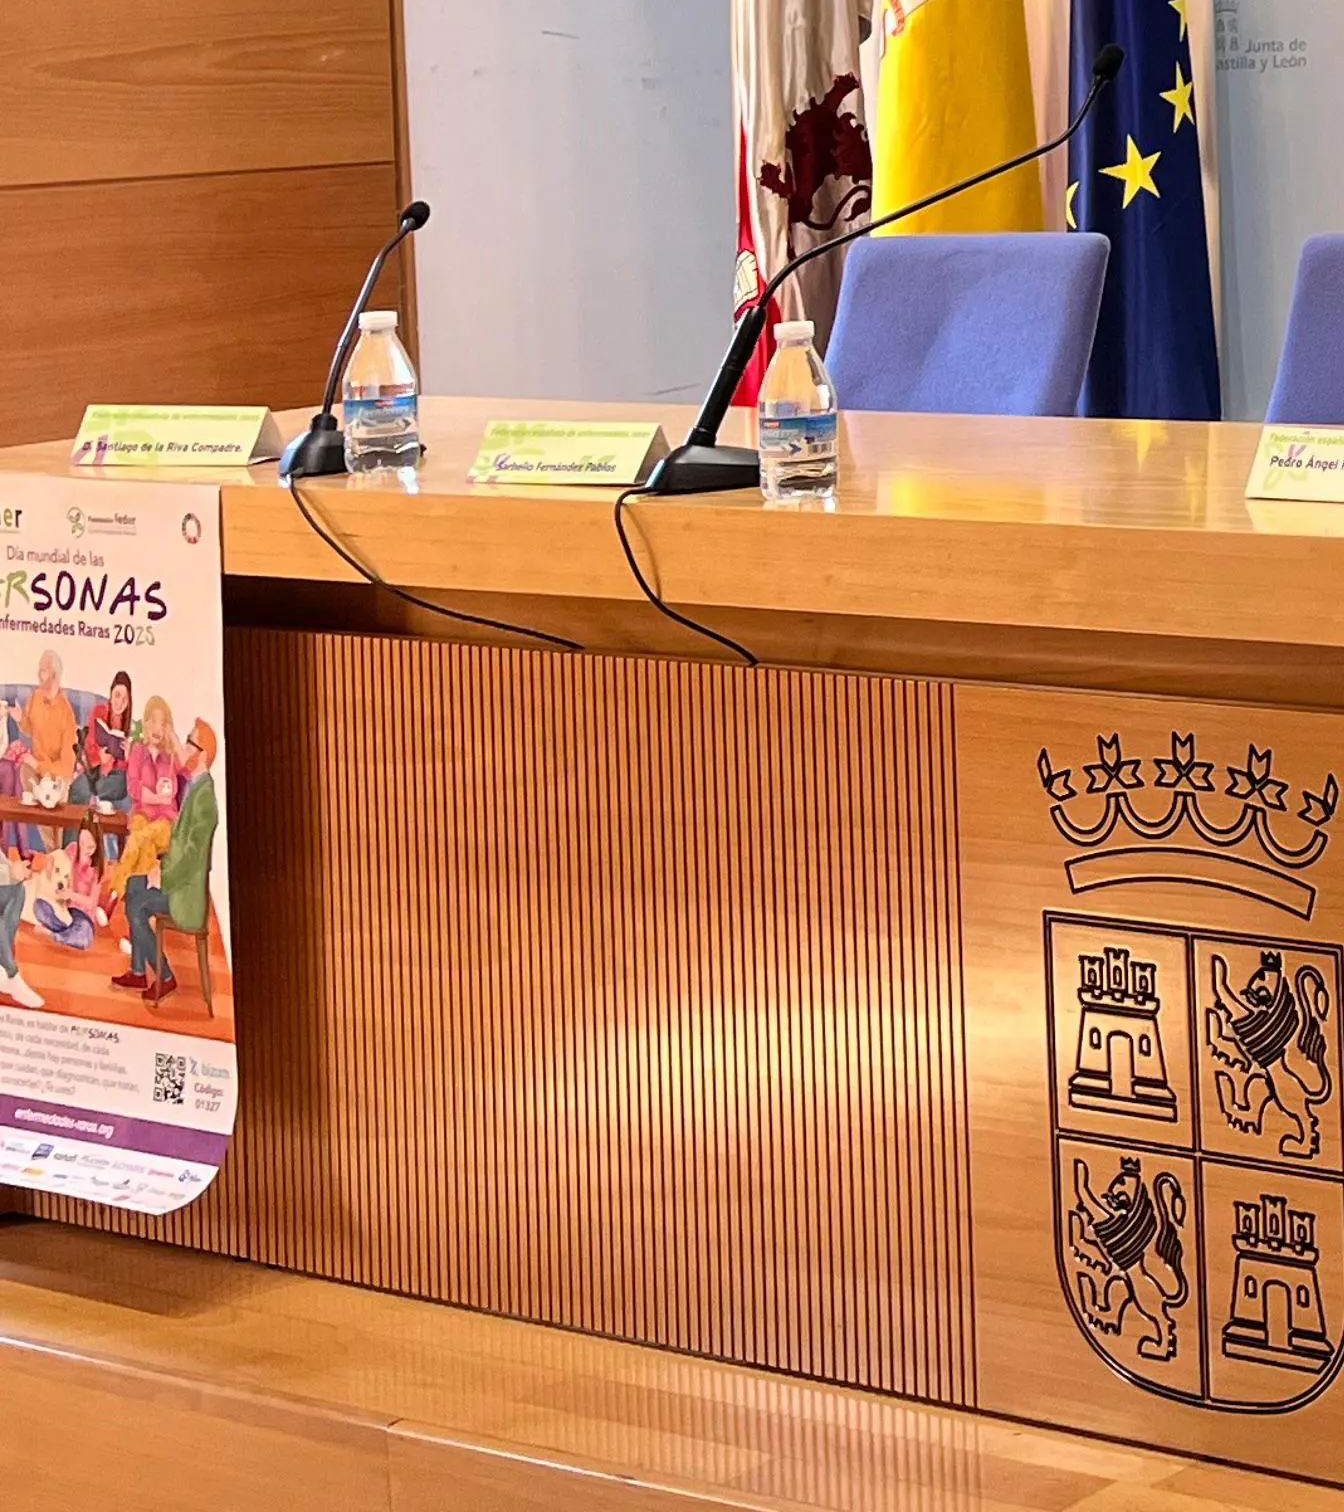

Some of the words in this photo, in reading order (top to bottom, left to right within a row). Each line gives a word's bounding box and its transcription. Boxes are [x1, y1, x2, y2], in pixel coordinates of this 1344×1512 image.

[1270, 454, 1303, 469] Pedro
[1306, 455, 1338, 472] Ángel
[0, 570, 167, 620] RSONAS
[0, 614, 75, 636] nfermedades
[78, 621, 110, 638] Raras
[114, 624, 155, 646] 2025
